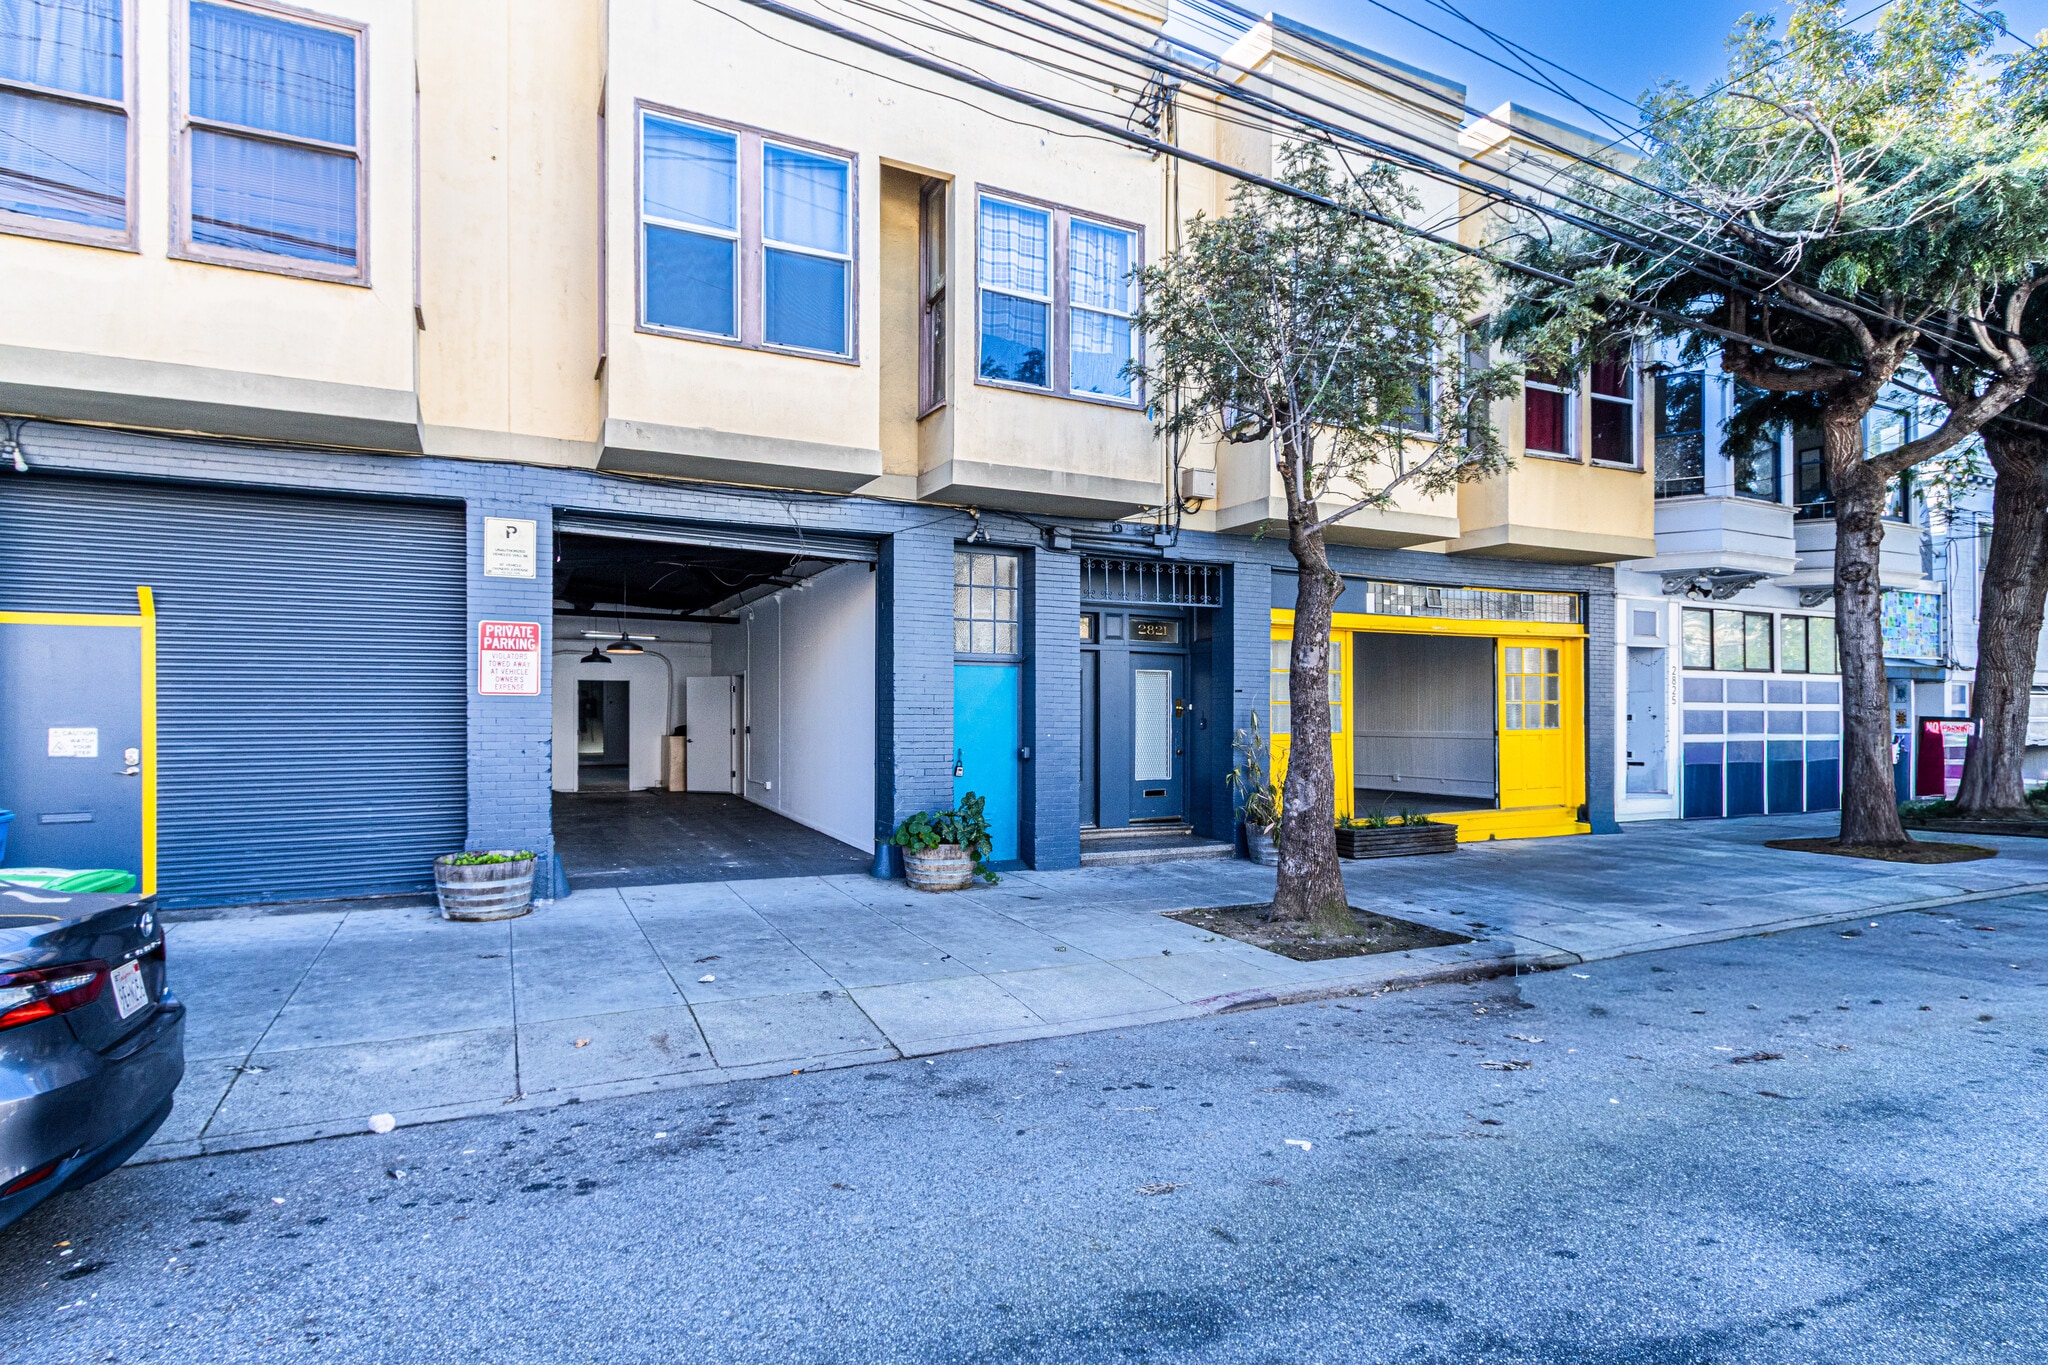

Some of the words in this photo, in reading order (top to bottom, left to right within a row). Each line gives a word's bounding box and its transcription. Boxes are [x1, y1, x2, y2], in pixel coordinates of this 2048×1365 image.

[485, 624, 535, 638] PRIVATE
[1138, 624, 1167, 636] 2821
[483, 637, 536, 650] PARKING
[1925, 721, 1940, 734] NO
